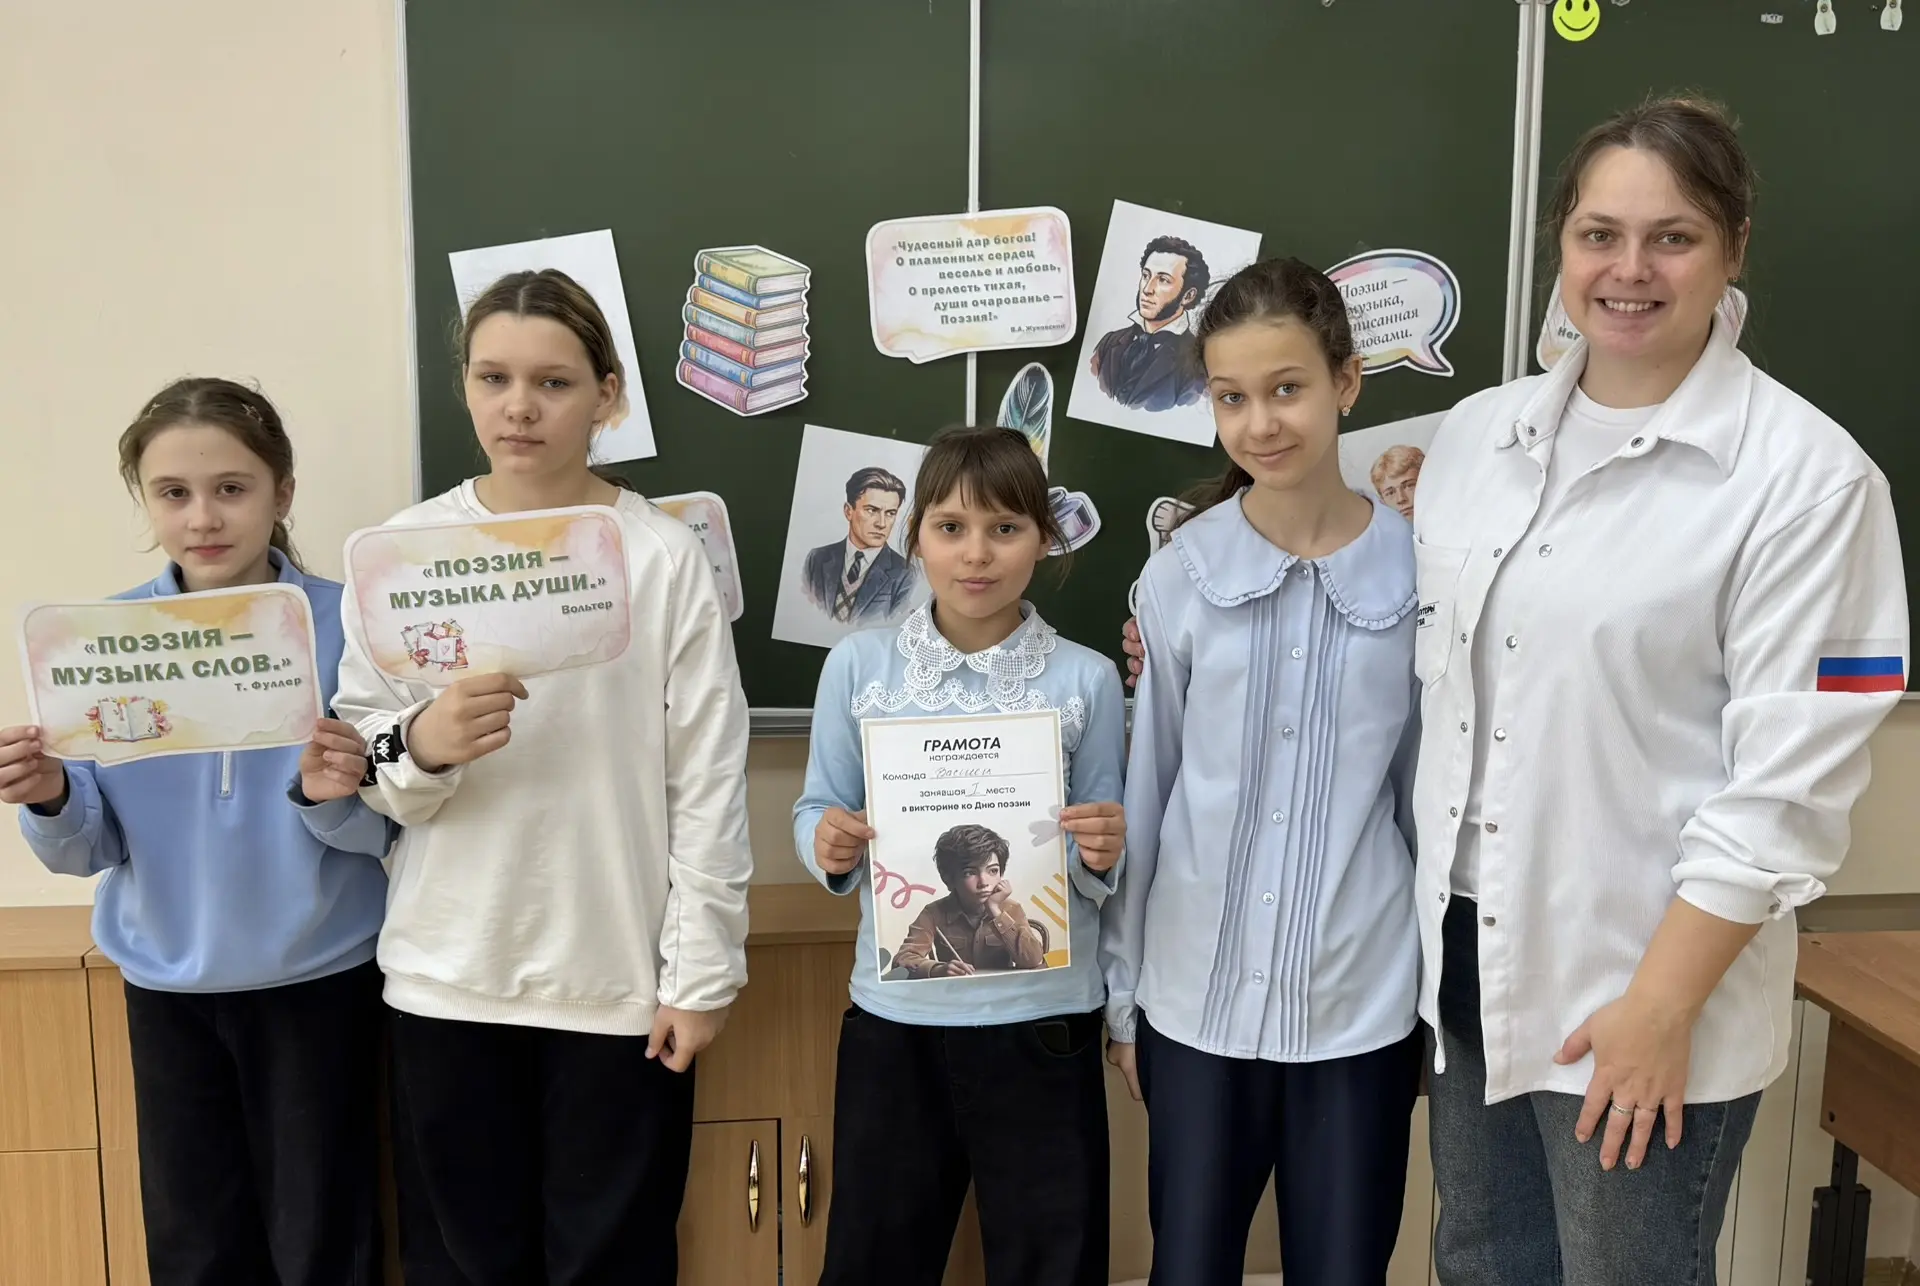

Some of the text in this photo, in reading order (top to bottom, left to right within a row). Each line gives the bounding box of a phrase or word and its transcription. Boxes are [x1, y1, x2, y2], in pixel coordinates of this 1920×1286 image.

[966, 237, 990, 249] дар
[994, 232, 1036, 245] богов!
[896, 250, 1035, 266] О пламенных сердец
[938, 263, 1061, 280] веселье и любовь,
[909, 281, 1026, 297] О прелесть тихая,
[1339, 280, 1388, 298] Поэзия
[934, 300, 968, 311] души
[971, 294, 1050, 308] очарованье
[1347, 295, 1404, 316] музыка,
[940, 312, 998, 325] Поэзия!»
[1353, 308, 1419, 331] писанная
[422, 551, 542, 579] «ПОЭЗИЯ
[388, 573, 606, 610] МУЗЫКА ДУШИ.»
[561, 600, 613, 616] Вольтер
[84, 628, 223, 656] «ПОЭЗИЯ
[51, 653, 292, 687] МУЗЫКА СЛОВ.»
[234, 676, 303, 692] Т. Фуллер
[923, 736, 1001, 752] ГРАМОТА
[929, 752, 999, 763] награждается
[882, 771, 927, 782] Команда
[919, 788, 966, 798] занявшая
[986, 786, 1016, 795] место
[909, 802, 959, 813] викторине
[975, 801, 995, 810] Дню
[998, 800, 1031, 809] поэзии
